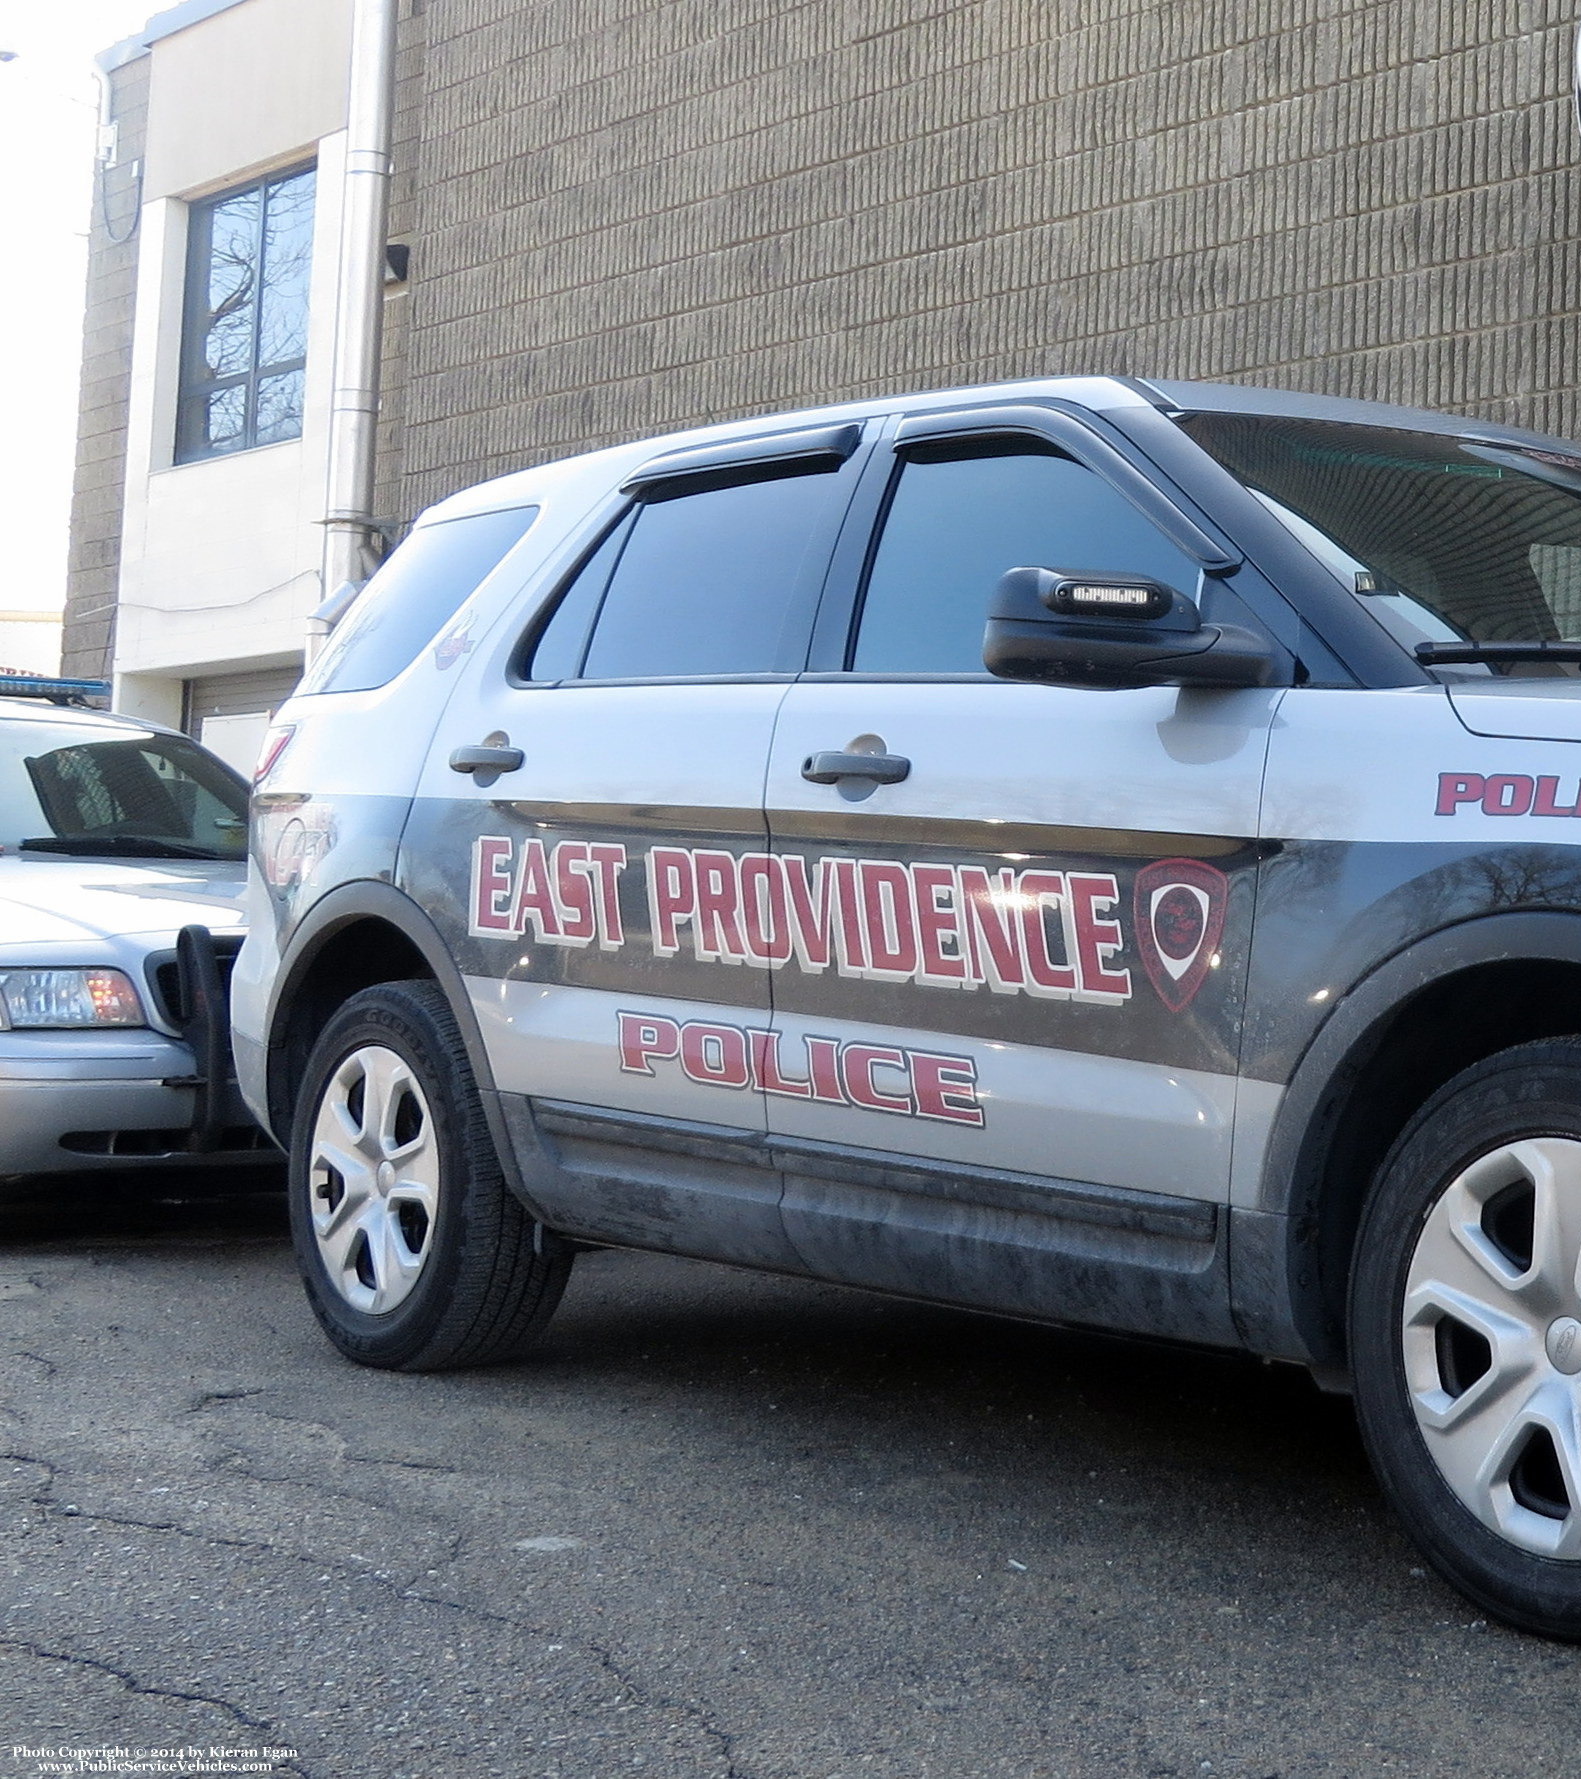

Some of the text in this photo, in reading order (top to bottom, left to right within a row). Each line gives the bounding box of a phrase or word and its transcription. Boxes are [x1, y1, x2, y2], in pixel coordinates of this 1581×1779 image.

[469, 834, 627, 951] EAST
[645, 845, 1134, 1006] PROVIDENCE
[617, 1009, 985, 1129] POLICE
